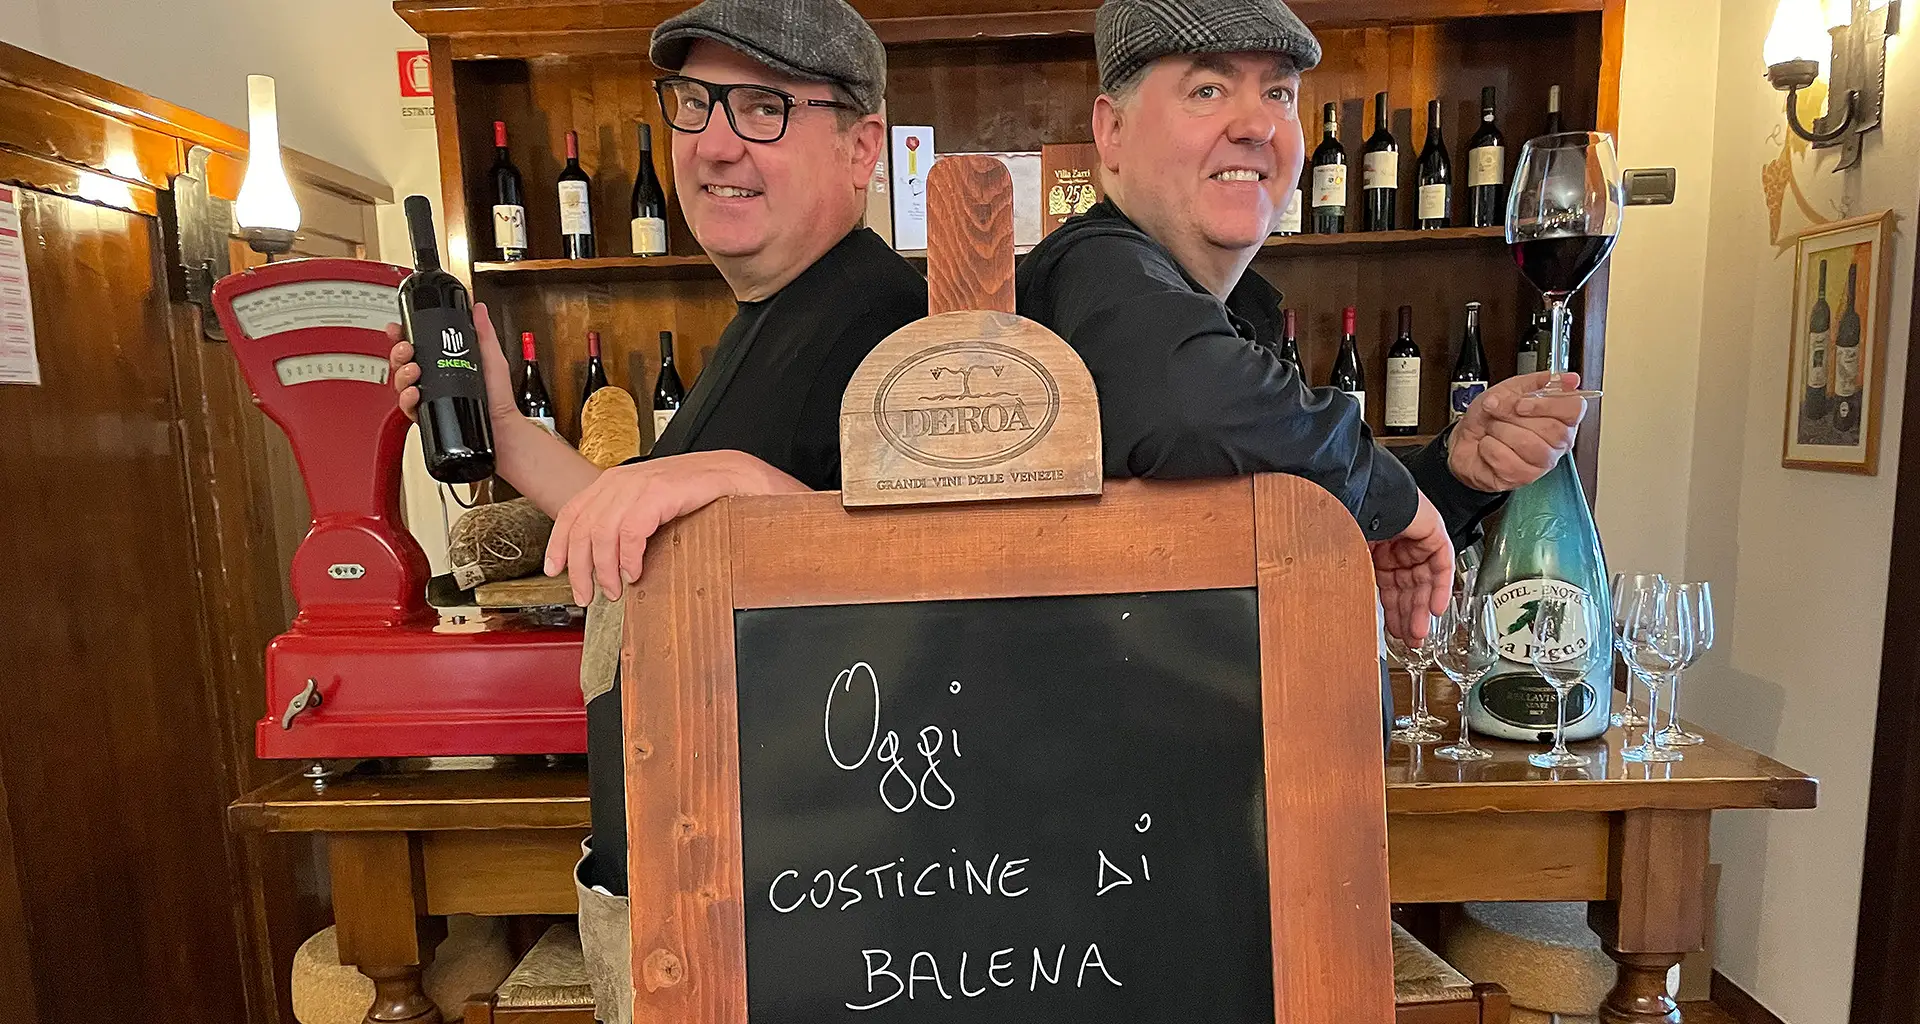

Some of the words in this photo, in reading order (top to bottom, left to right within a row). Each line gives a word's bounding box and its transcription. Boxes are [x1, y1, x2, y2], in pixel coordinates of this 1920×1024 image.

[401, 107, 435, 117] ESTINTO
[1066, 185, 1081, 204] 25
[901, 398, 1035, 439] DEROÀ
[877, 478, 927, 491] GRANDI
[932, 476, 962, 487] VINI
[968, 473, 1004, 486] DELLE
[1010, 470, 1065, 483] VENEZIE
[1494, 586, 1531, 609] HOTEL
[824, 661, 962, 812] Oggi
[845, 943, 1123, 1010] BALENA
